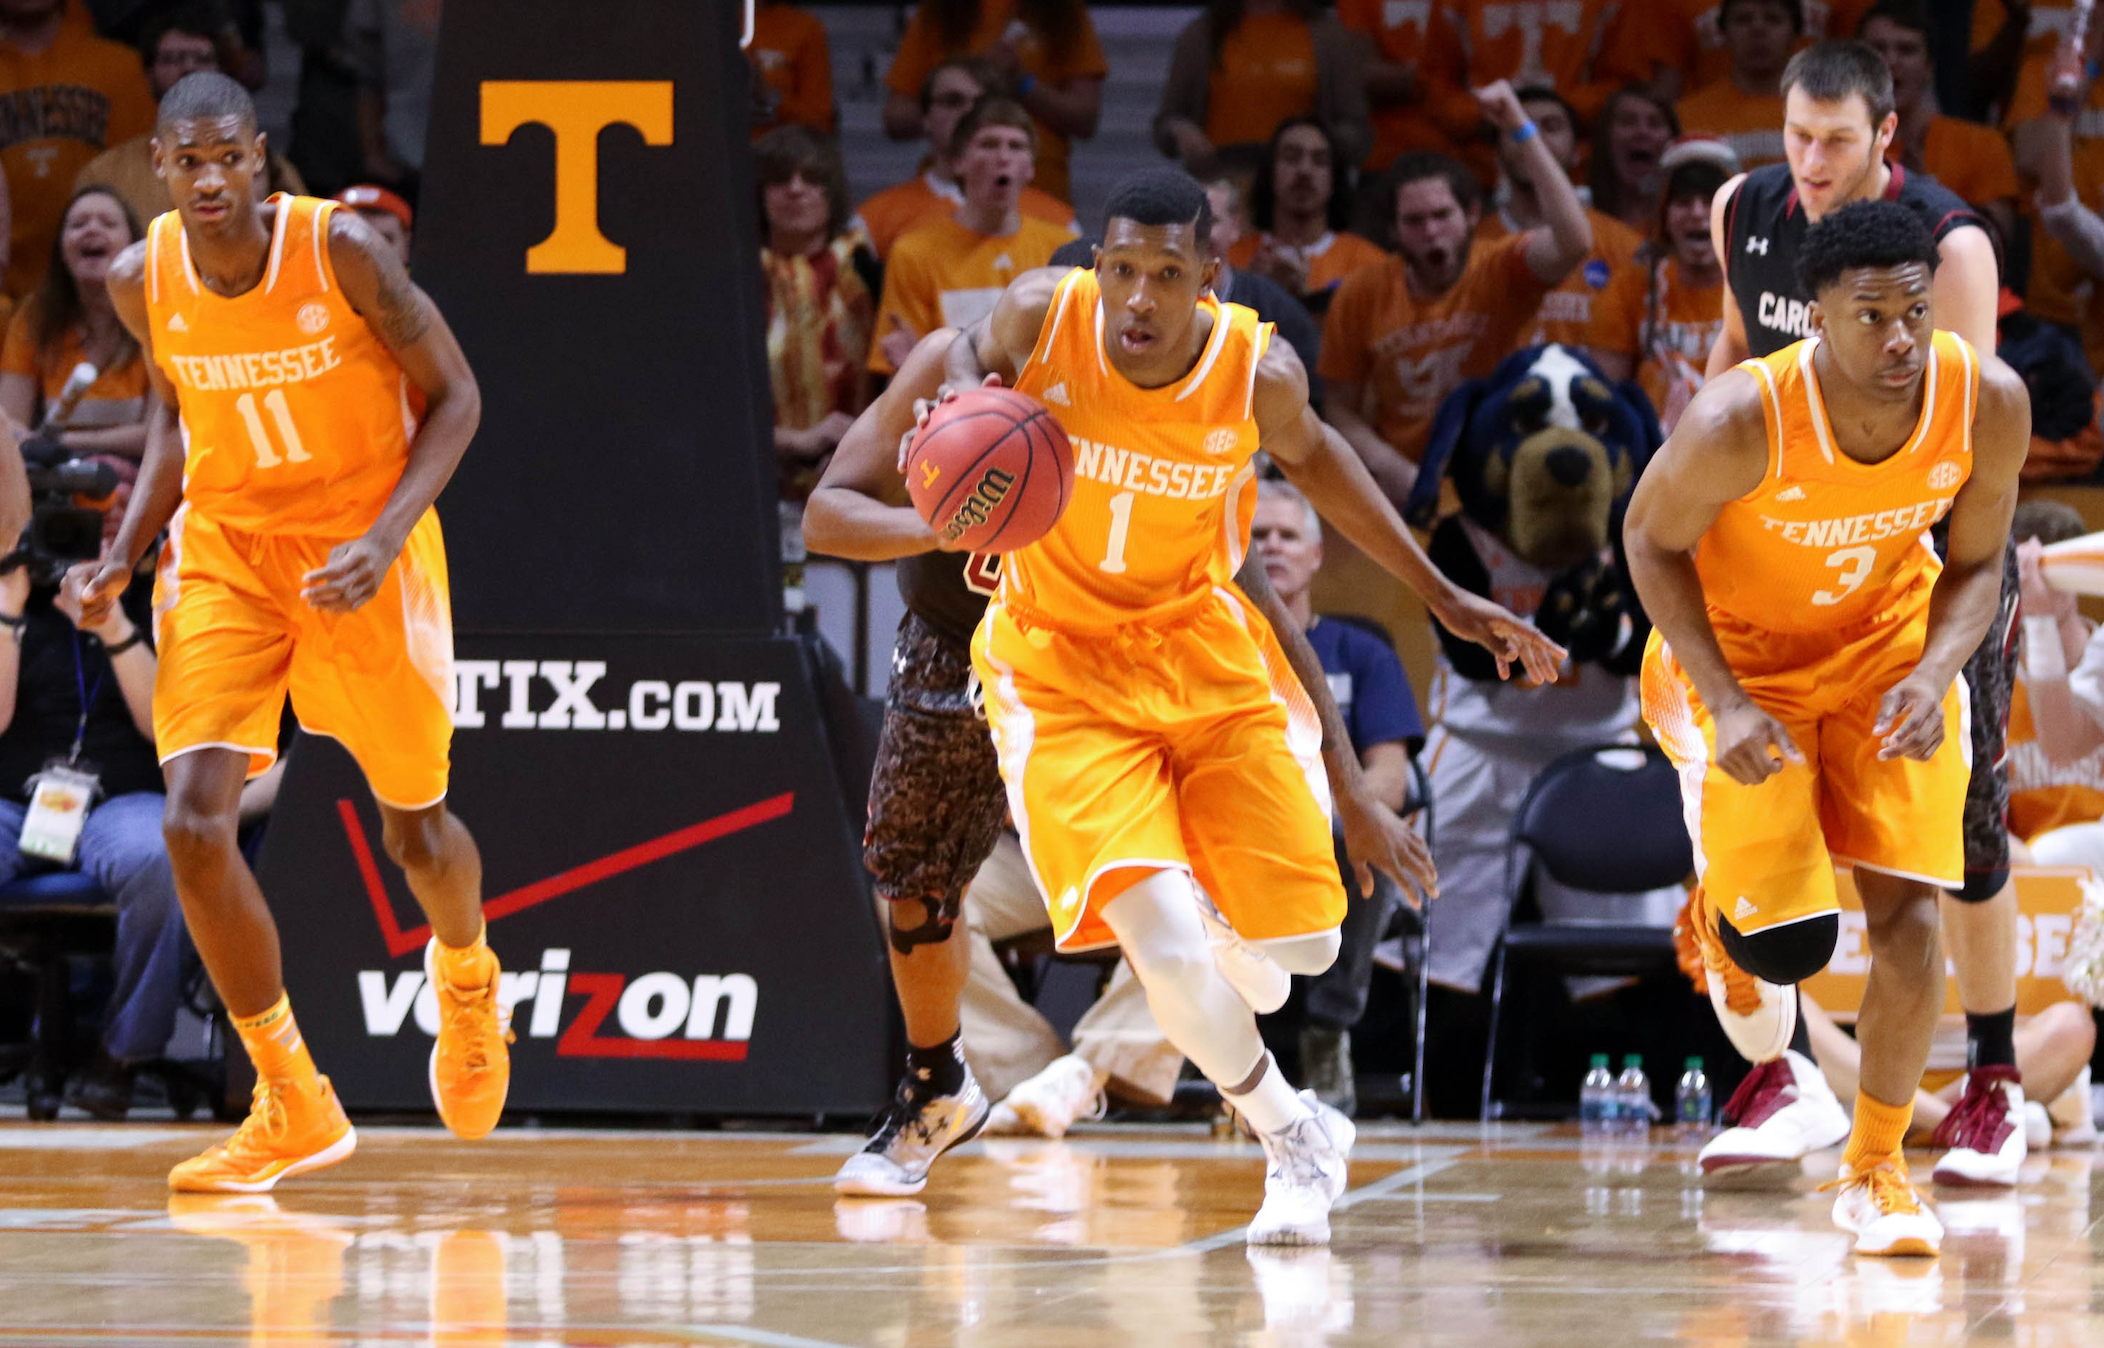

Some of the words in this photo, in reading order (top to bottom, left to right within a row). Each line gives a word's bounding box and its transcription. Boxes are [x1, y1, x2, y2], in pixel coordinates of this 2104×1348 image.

[480, 81, 674, 274] T
[170, 335, 341, 391] TENNESSEE
[236, 388, 313, 468] 11
[1206, 430, 1237, 451] SEC
[1929, 463, 1960, 487] SEC
[1099, 491, 1134, 573] 1
[1759, 497, 1954, 548] TENNESSEE
[1812, 545, 1877, 606] 3
